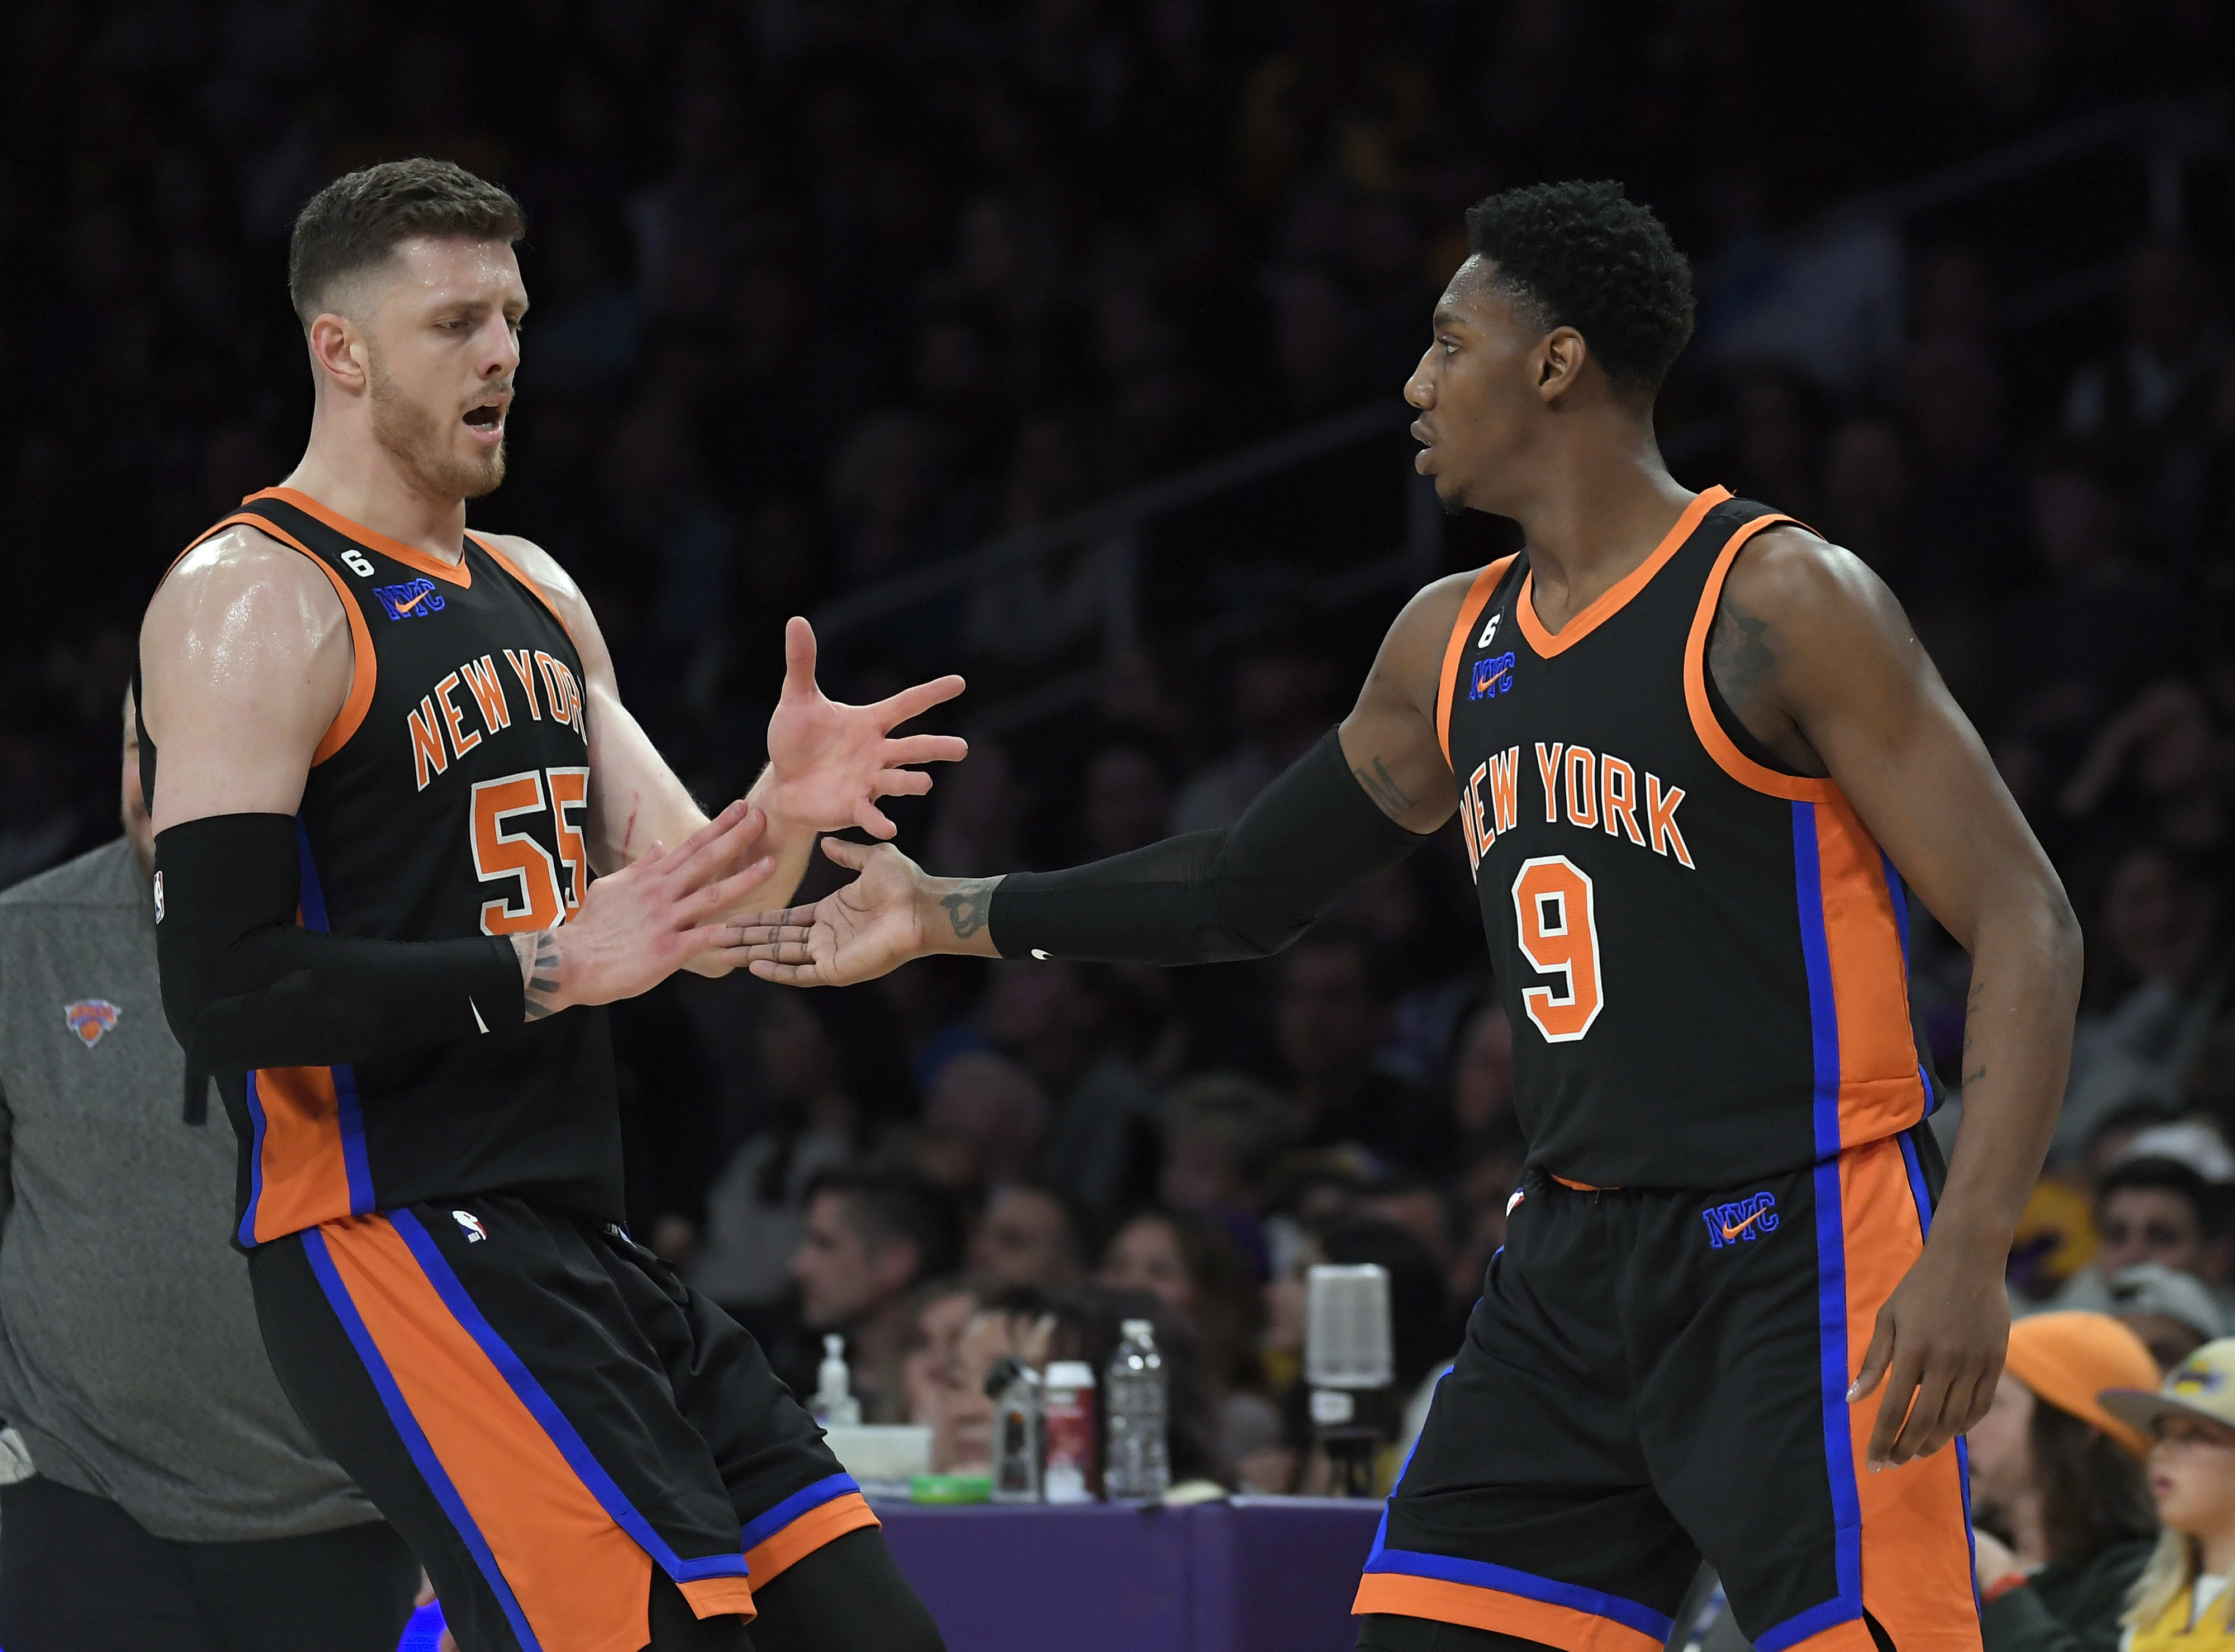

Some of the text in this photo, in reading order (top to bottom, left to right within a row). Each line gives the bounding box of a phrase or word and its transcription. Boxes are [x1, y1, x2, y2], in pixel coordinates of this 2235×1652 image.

[341, 549, 374, 577] 6
[373, 578, 445, 621] NYC
[1478, 613, 1501, 649] 6
[1469, 651, 1515, 701] NYC
[407, 649, 588, 792] NEW YOR
[1459, 742, 1695, 885] NEW YORK
[469, 767, 589, 936] 55
[1511, 855, 1604, 1043] 9
[1703, 1191, 1780, 1249] NYC
